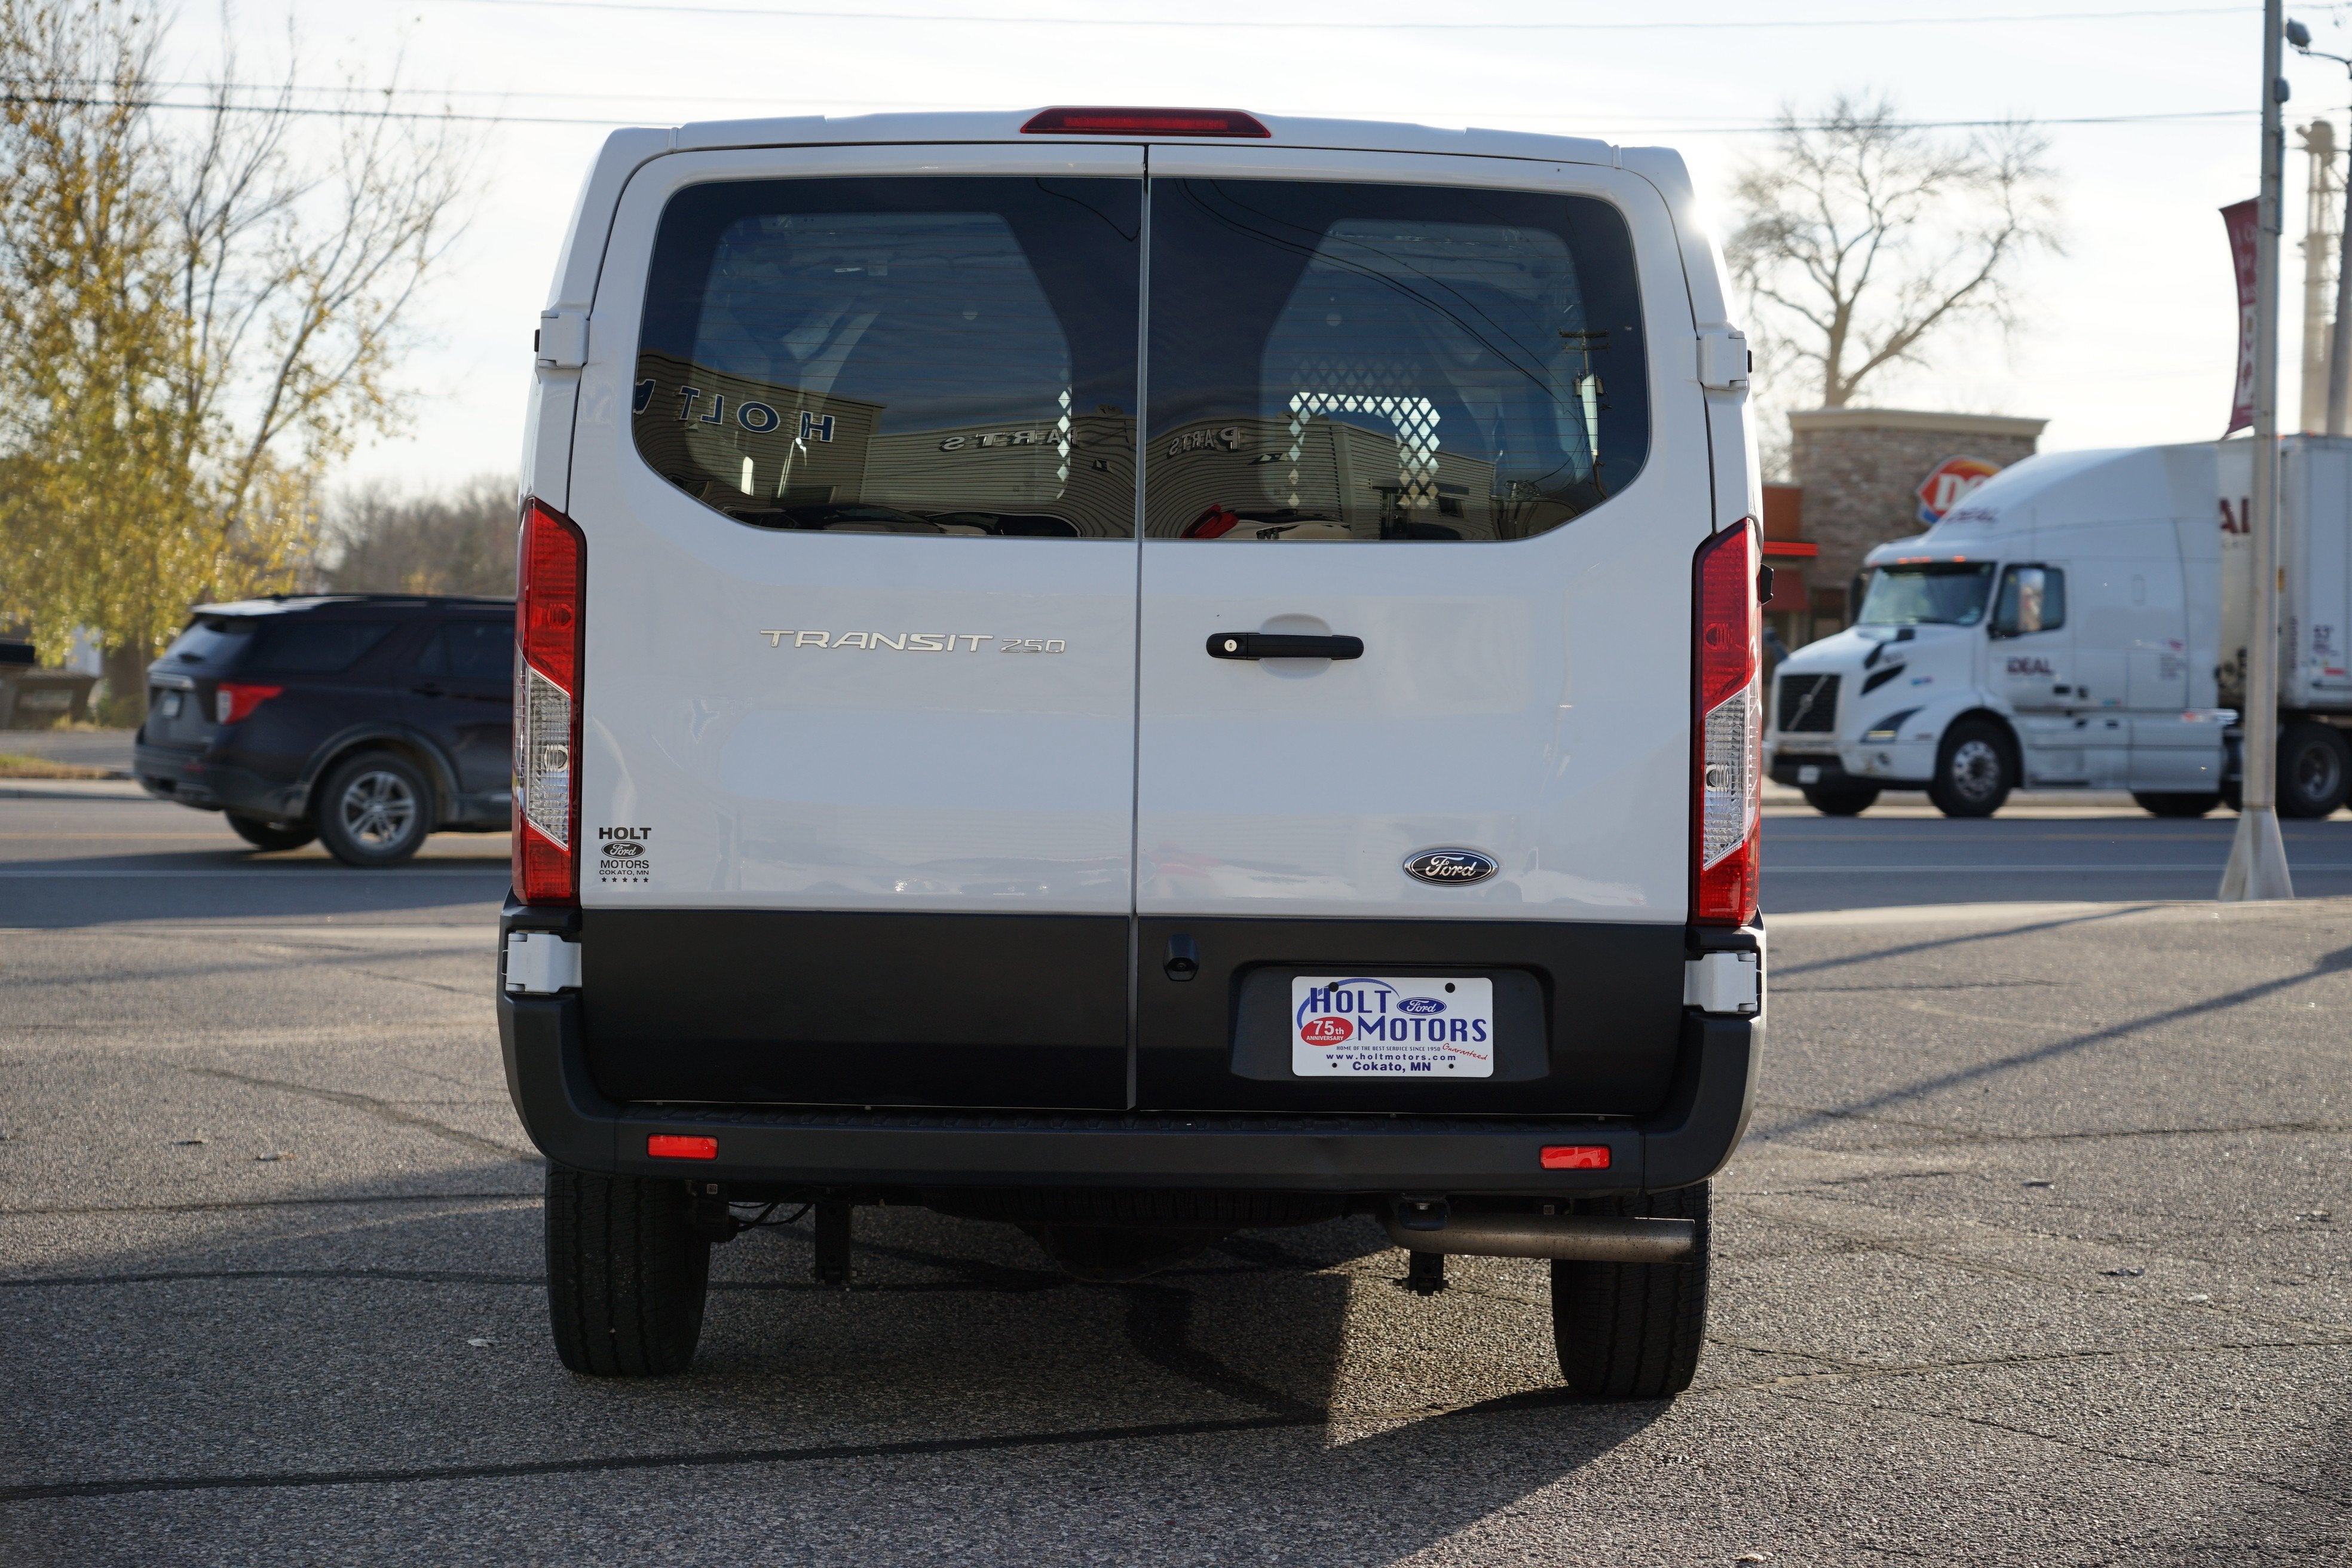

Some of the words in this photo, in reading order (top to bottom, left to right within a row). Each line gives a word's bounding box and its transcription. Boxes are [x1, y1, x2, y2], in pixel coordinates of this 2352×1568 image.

[760, 630, 994, 652] TRANSIT
[1000, 639, 1066, 653] 250
[599, 827, 651, 840] HOLT
[610, 843, 637, 856] Ford
[601, 860, 650, 868] MOTORS
[1425, 856, 1477, 876] Ford
[1310, 987, 1392, 1013] HOLT
[1406, 999, 1437, 1012] Ford
[1313, 1020, 1345, 1035] 75th
[1358, 1015, 1487, 1042] MOTORS
[1443, 1043, 1488, 1061] Guaranteed
[1353, 1061, 1406, 1073] Cokato,
[1410, 1062, 1431, 1071] MN
